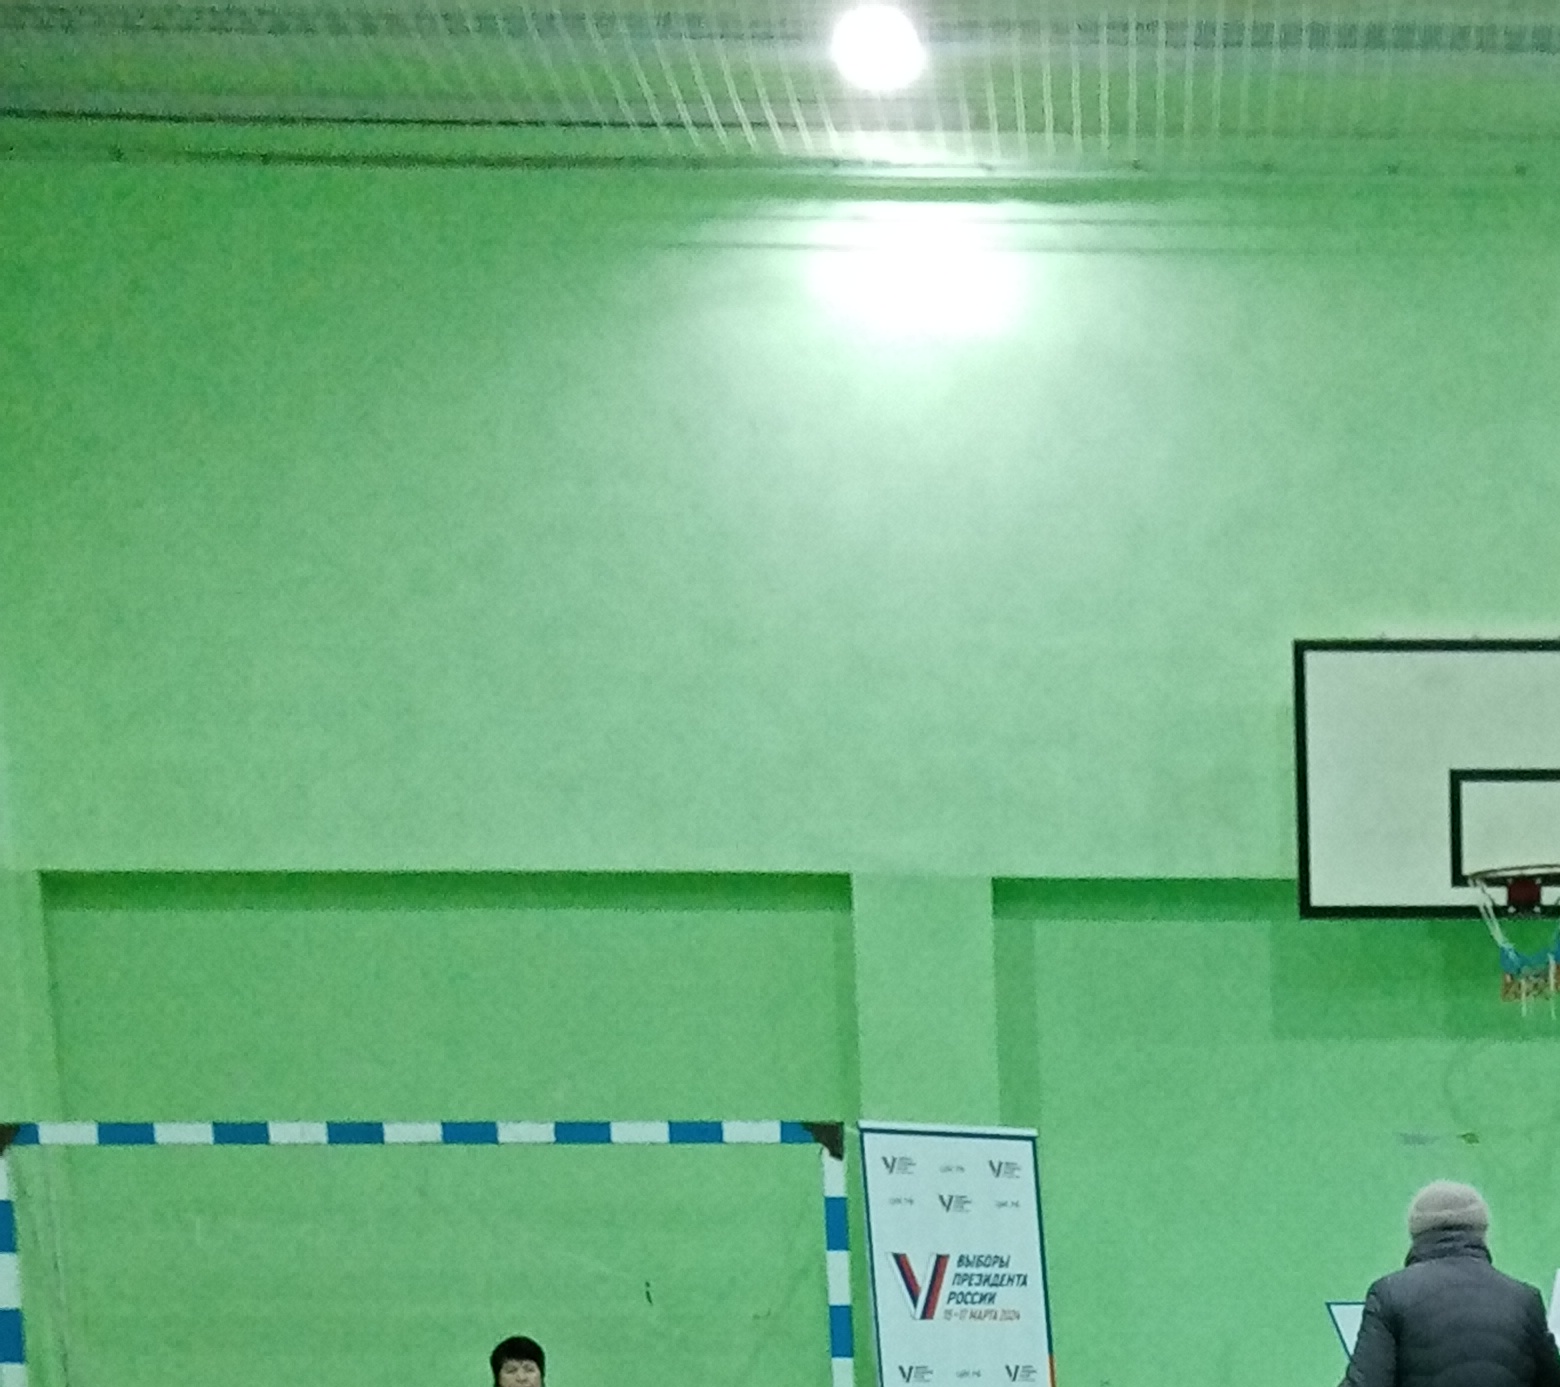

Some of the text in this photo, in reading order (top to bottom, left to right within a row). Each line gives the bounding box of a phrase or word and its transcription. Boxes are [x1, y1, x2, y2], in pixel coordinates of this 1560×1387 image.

[956, 1254, 1011, 1269] ВЫБОРЫ
[951, 1272, 1028, 1288] ПРЕЗИДЕНТА
[946, 1291, 998, 1305] РОССИИ
